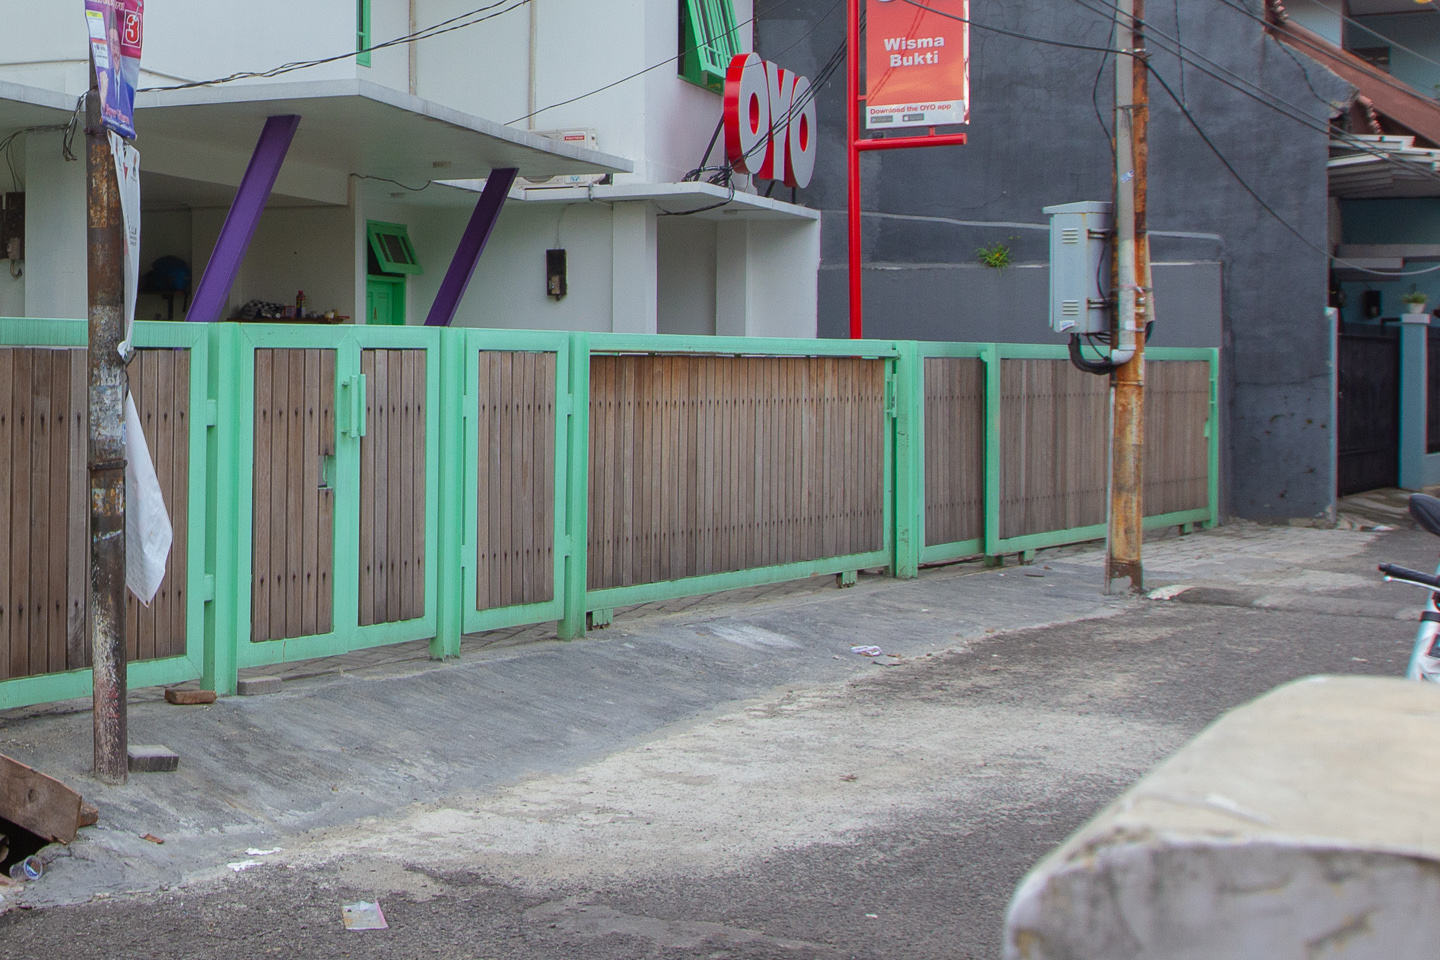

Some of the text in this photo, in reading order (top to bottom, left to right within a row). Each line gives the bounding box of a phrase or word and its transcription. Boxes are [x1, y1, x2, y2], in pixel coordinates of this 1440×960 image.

[126, 14, 140, 43] 3
[884, 37, 944, 51] Wisma
[889, 51, 939, 67] Bukti
[870, 106, 905, 115] Download
[724, 52, 817, 189] OYO
